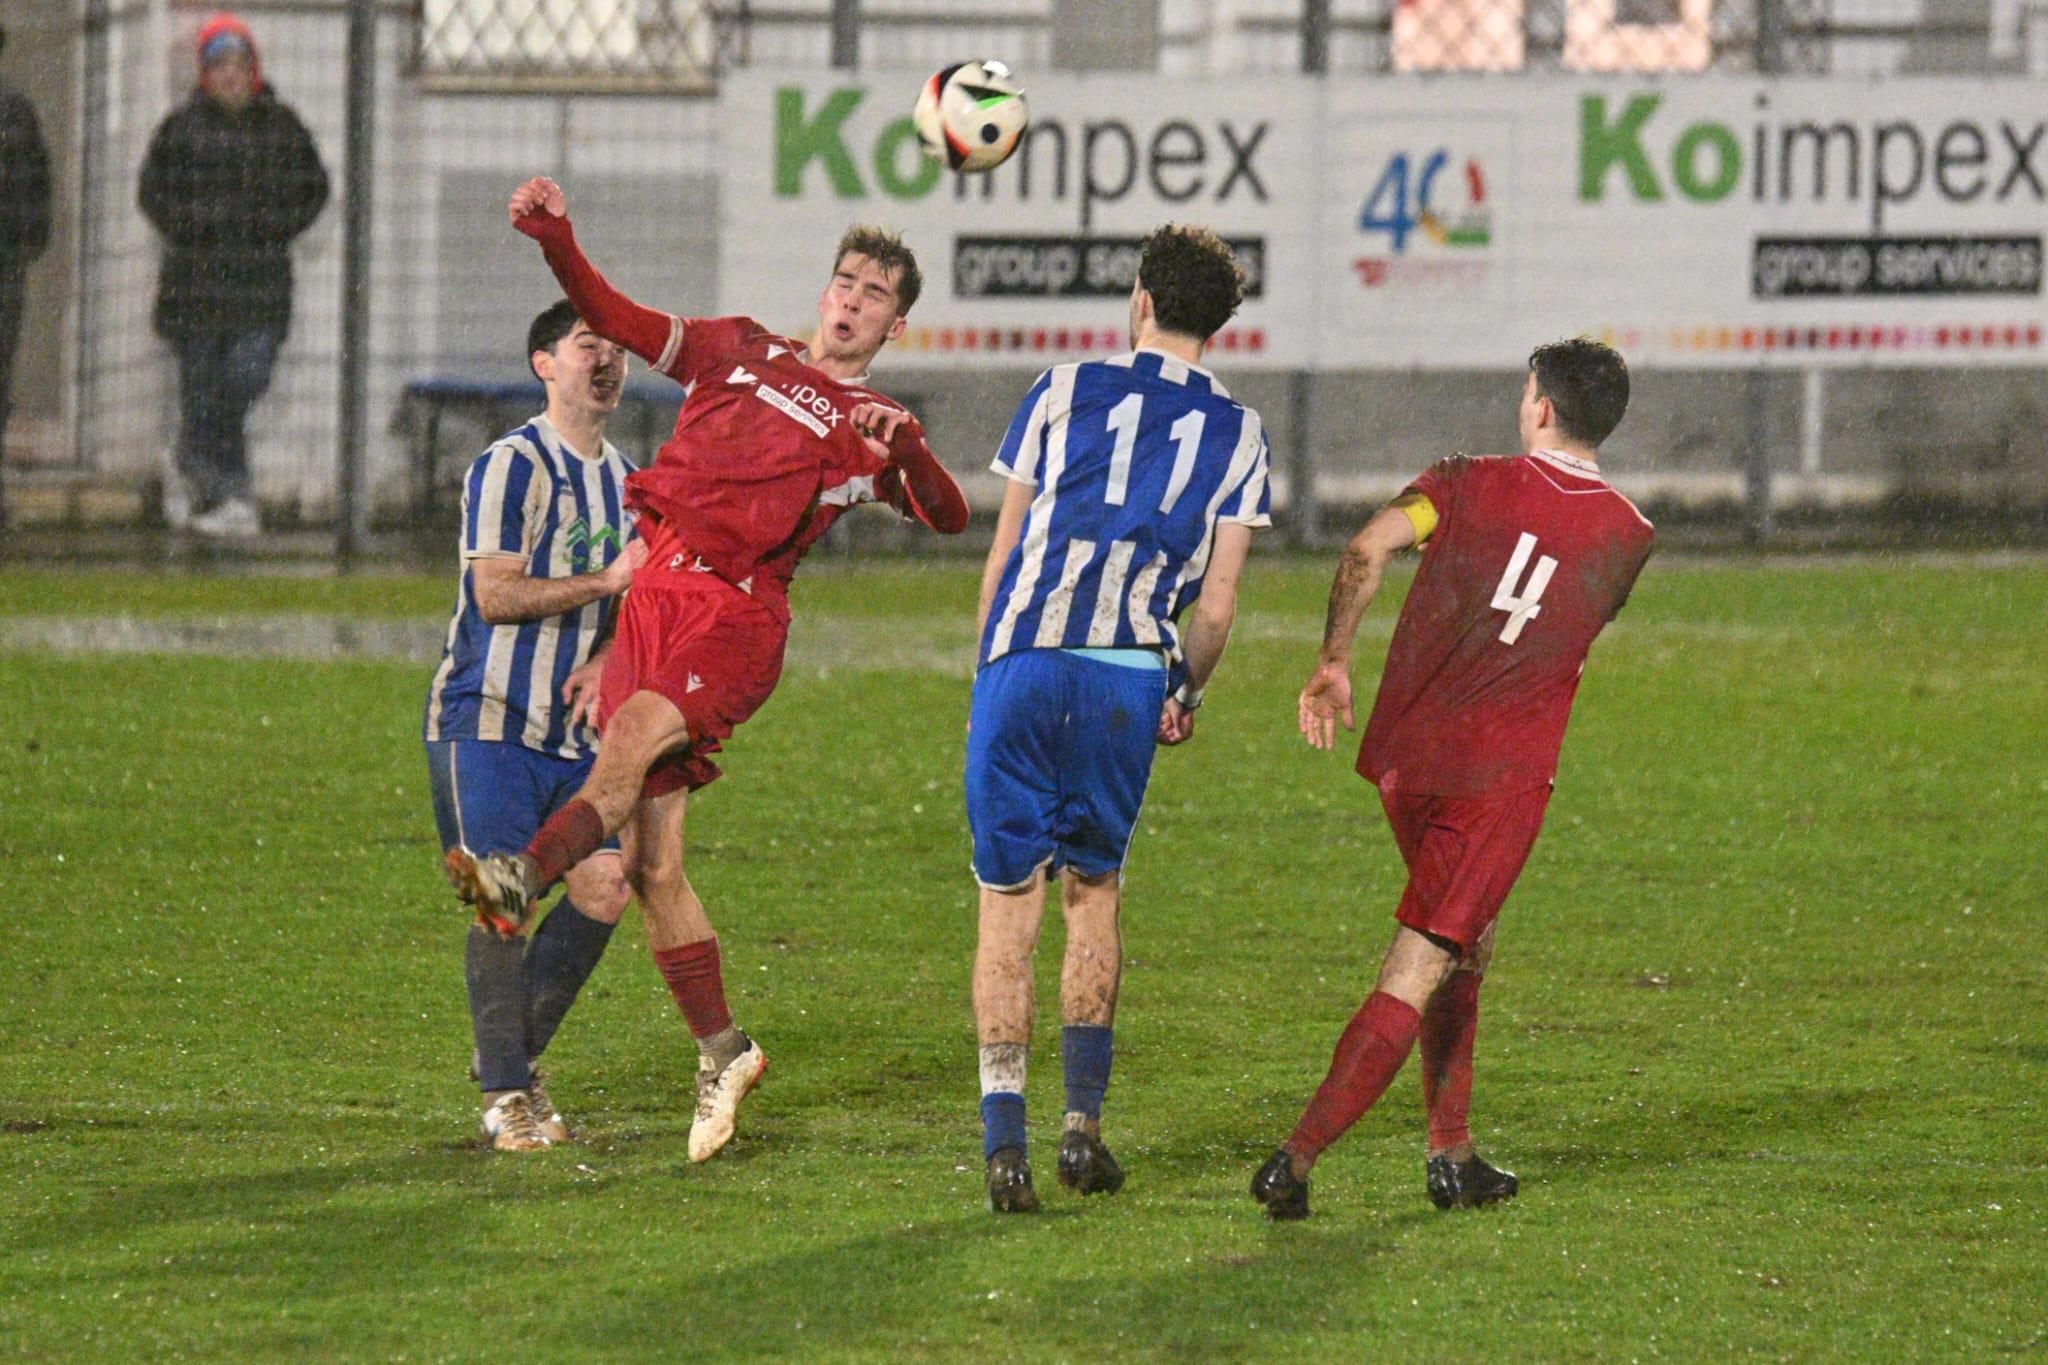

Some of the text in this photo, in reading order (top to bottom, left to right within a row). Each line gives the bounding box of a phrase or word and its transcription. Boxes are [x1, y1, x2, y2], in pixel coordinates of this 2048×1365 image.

[773, 86, 1270, 231] Kompex
[1579, 94, 2047, 233] Koimpex
[957, 245, 1079, 294] group
[1757, 244, 2038, 293] group services
[760, 387, 826, 435] group services
[1104, 392, 1206, 515] 11
[1490, 531, 1559, 646] 4
